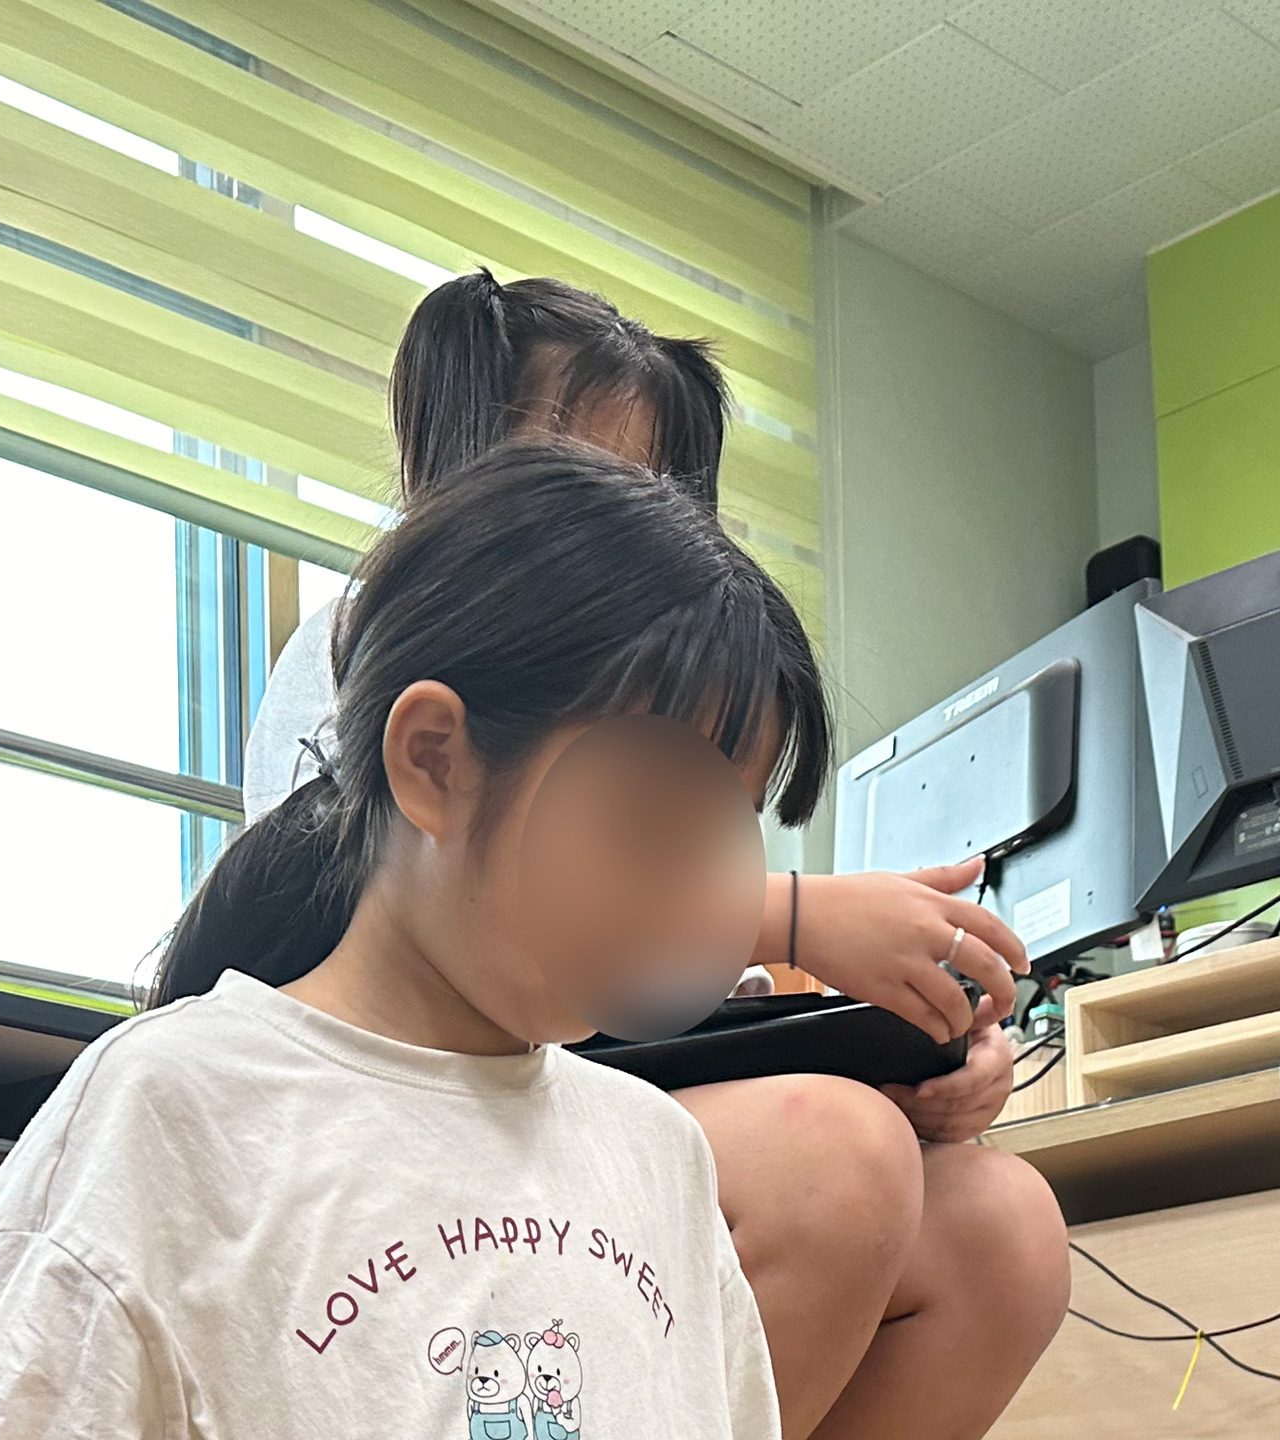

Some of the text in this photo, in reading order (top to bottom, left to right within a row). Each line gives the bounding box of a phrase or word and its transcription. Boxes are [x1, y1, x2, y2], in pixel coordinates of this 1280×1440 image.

[296, 1216, 676, 1354] LOVE HAPPY SWEET
